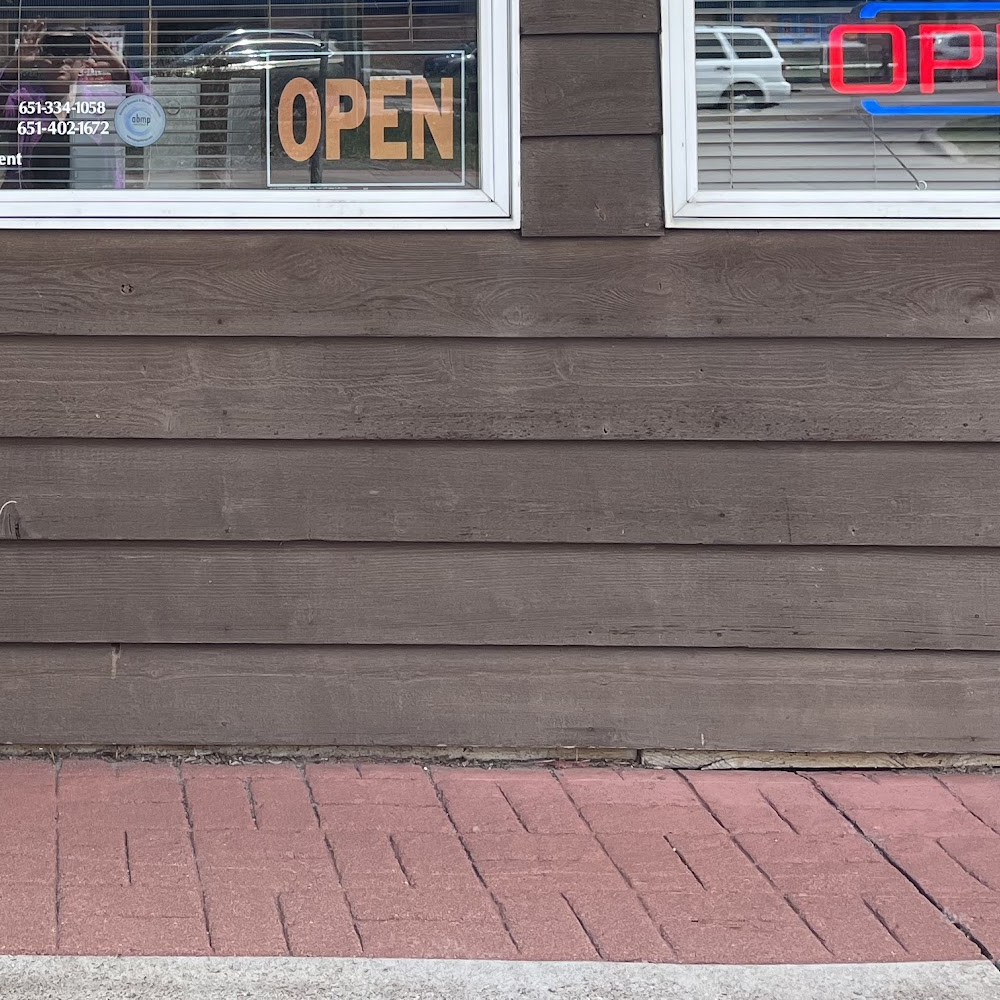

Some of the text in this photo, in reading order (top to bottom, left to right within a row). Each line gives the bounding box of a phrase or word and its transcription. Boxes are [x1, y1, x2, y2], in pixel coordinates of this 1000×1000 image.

[829, 24, 1000, 94] OP
[19, 101, 106, 115] 651-334-1058
[131, 113, 151, 126] abmp
[277, 76, 454, 162] OPEN
[17, 121, 110, 135] 651-402-1672
